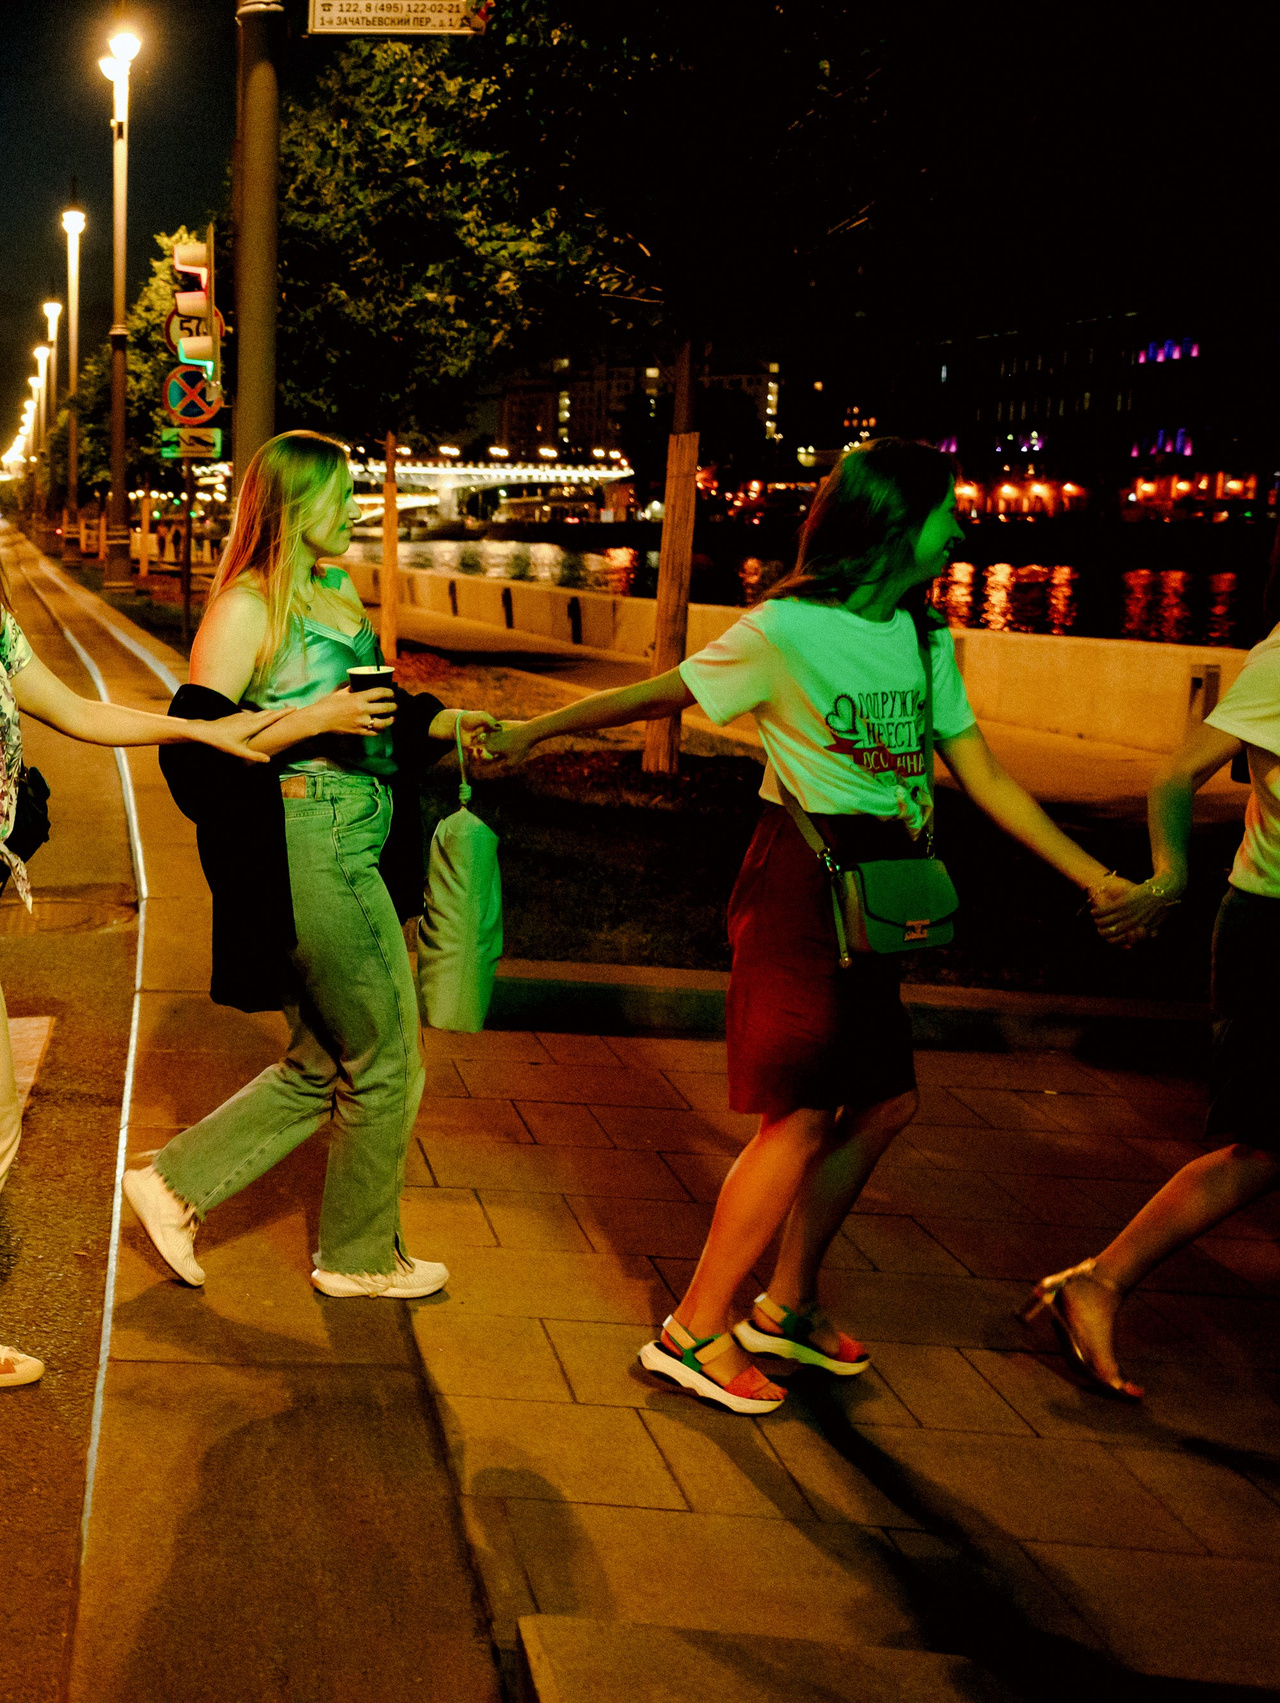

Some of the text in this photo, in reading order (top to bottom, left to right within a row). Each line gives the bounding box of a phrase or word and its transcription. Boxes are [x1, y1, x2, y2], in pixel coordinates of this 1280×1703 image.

[365, 3, 373, 13] 8
[375, 2, 404, 14] (495)
[406, 3, 461, 14] 122-02-21
[336, 15, 411, 26] ЗАЧАТЬЕВСКИЙ
